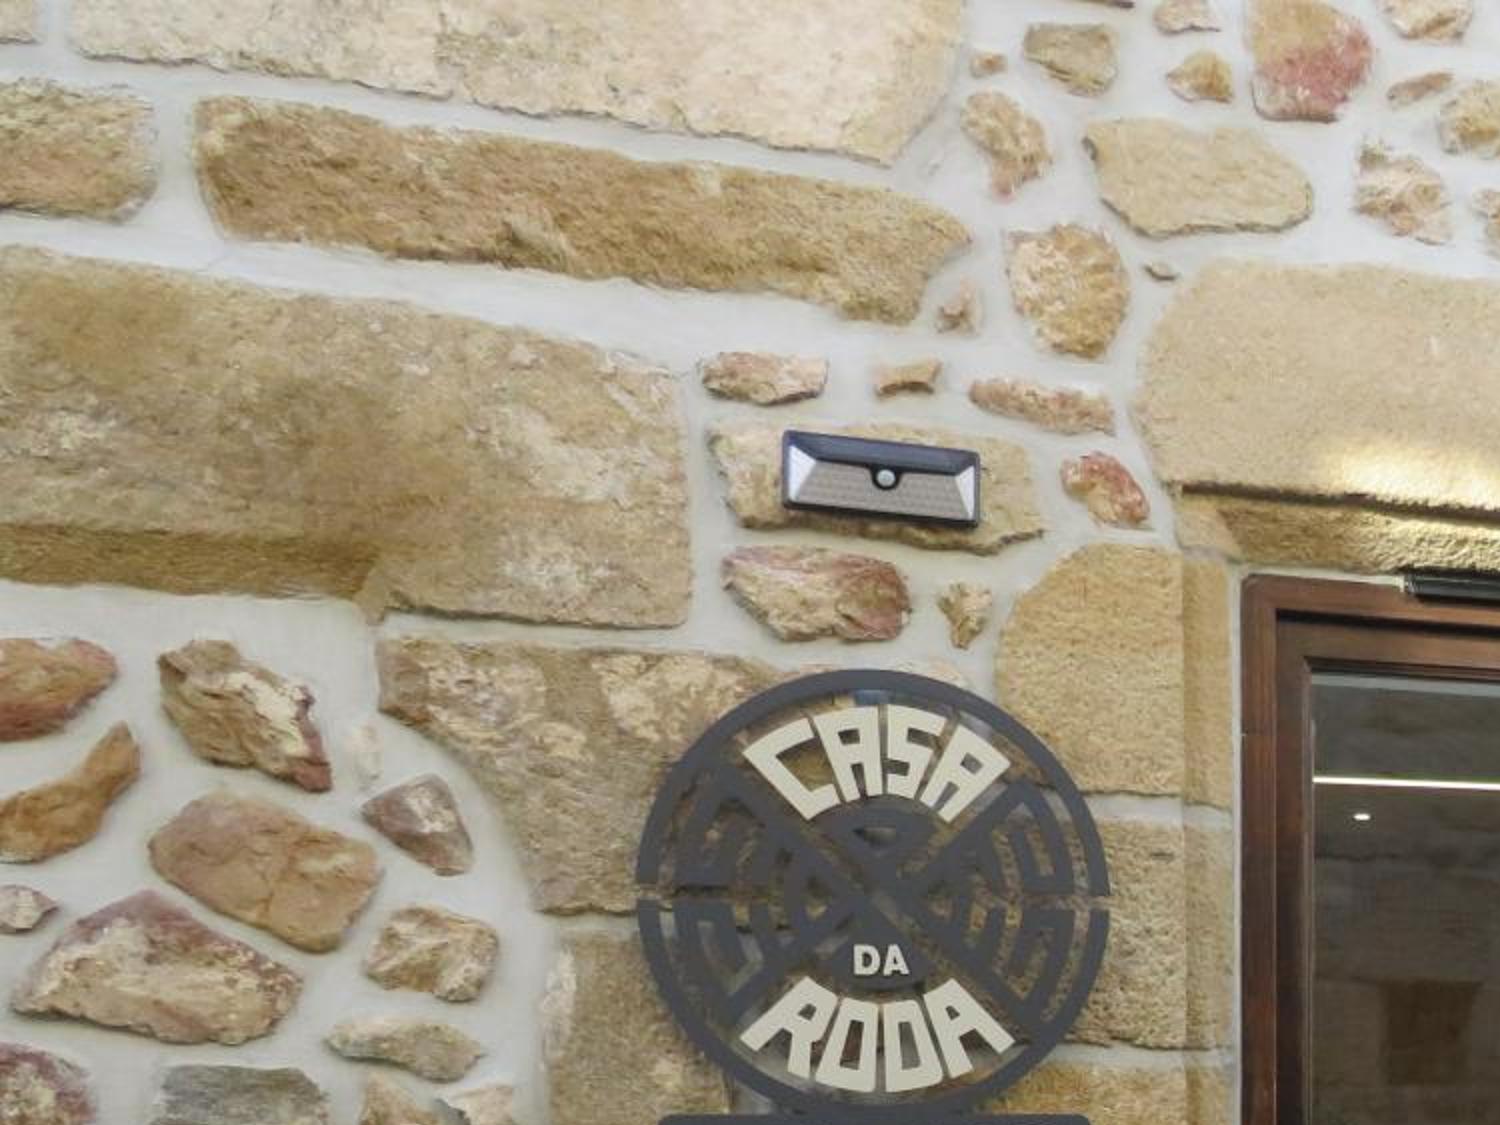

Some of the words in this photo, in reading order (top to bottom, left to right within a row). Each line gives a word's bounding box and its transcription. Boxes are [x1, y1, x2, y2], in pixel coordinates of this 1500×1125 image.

[742, 704, 1012, 822] CASA
[852, 943, 910, 977] DA
[739, 975, 1016, 1093] RODA
